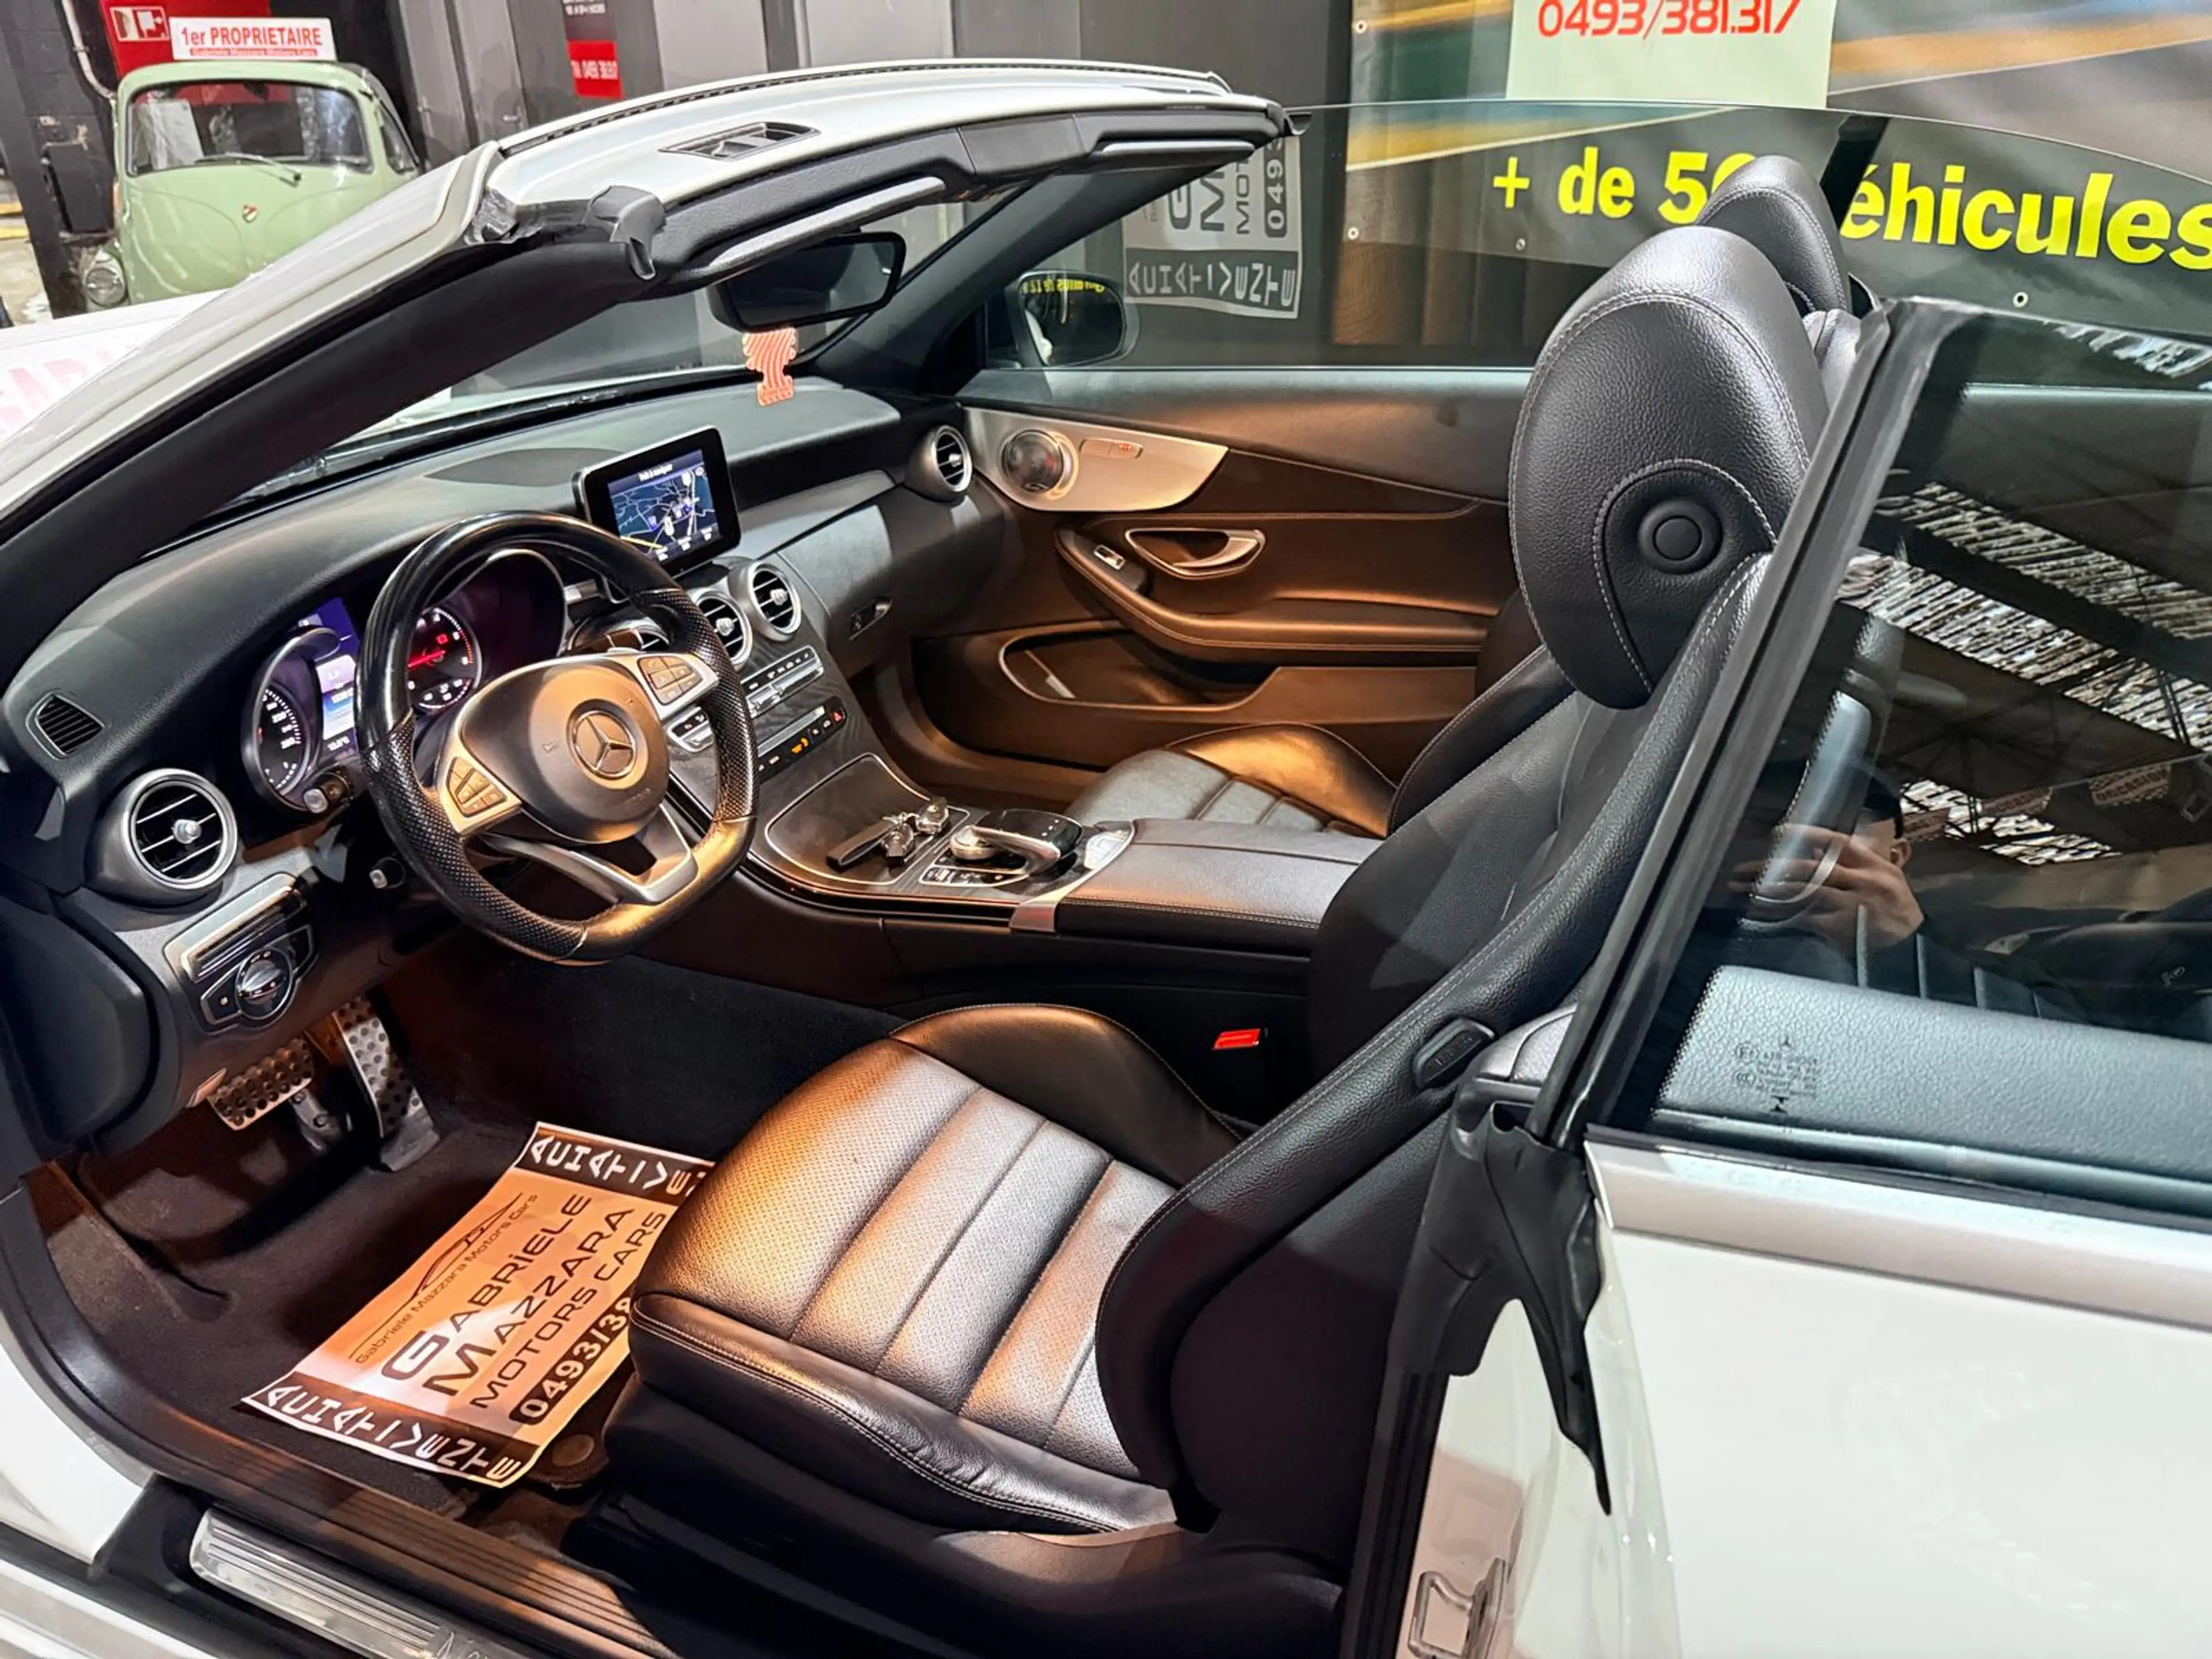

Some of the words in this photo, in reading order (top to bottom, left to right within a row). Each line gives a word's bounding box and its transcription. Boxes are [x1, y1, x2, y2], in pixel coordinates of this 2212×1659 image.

[181, 27, 205, 46] 1er
[210, 26, 323, 46] PROPRIETAIRE
[1558, 146, 1635, 218] de
[1839, 162, 2212, 270] éhicules
[355, 1313, 412, 1363] Gabriele
[411, 1263, 468, 1313] Mazzara
[422, 1208, 635, 1397] MAZZARA
[469, 1286, 597, 1409] MOTORS
[593, 1211, 667, 1281] CARS
